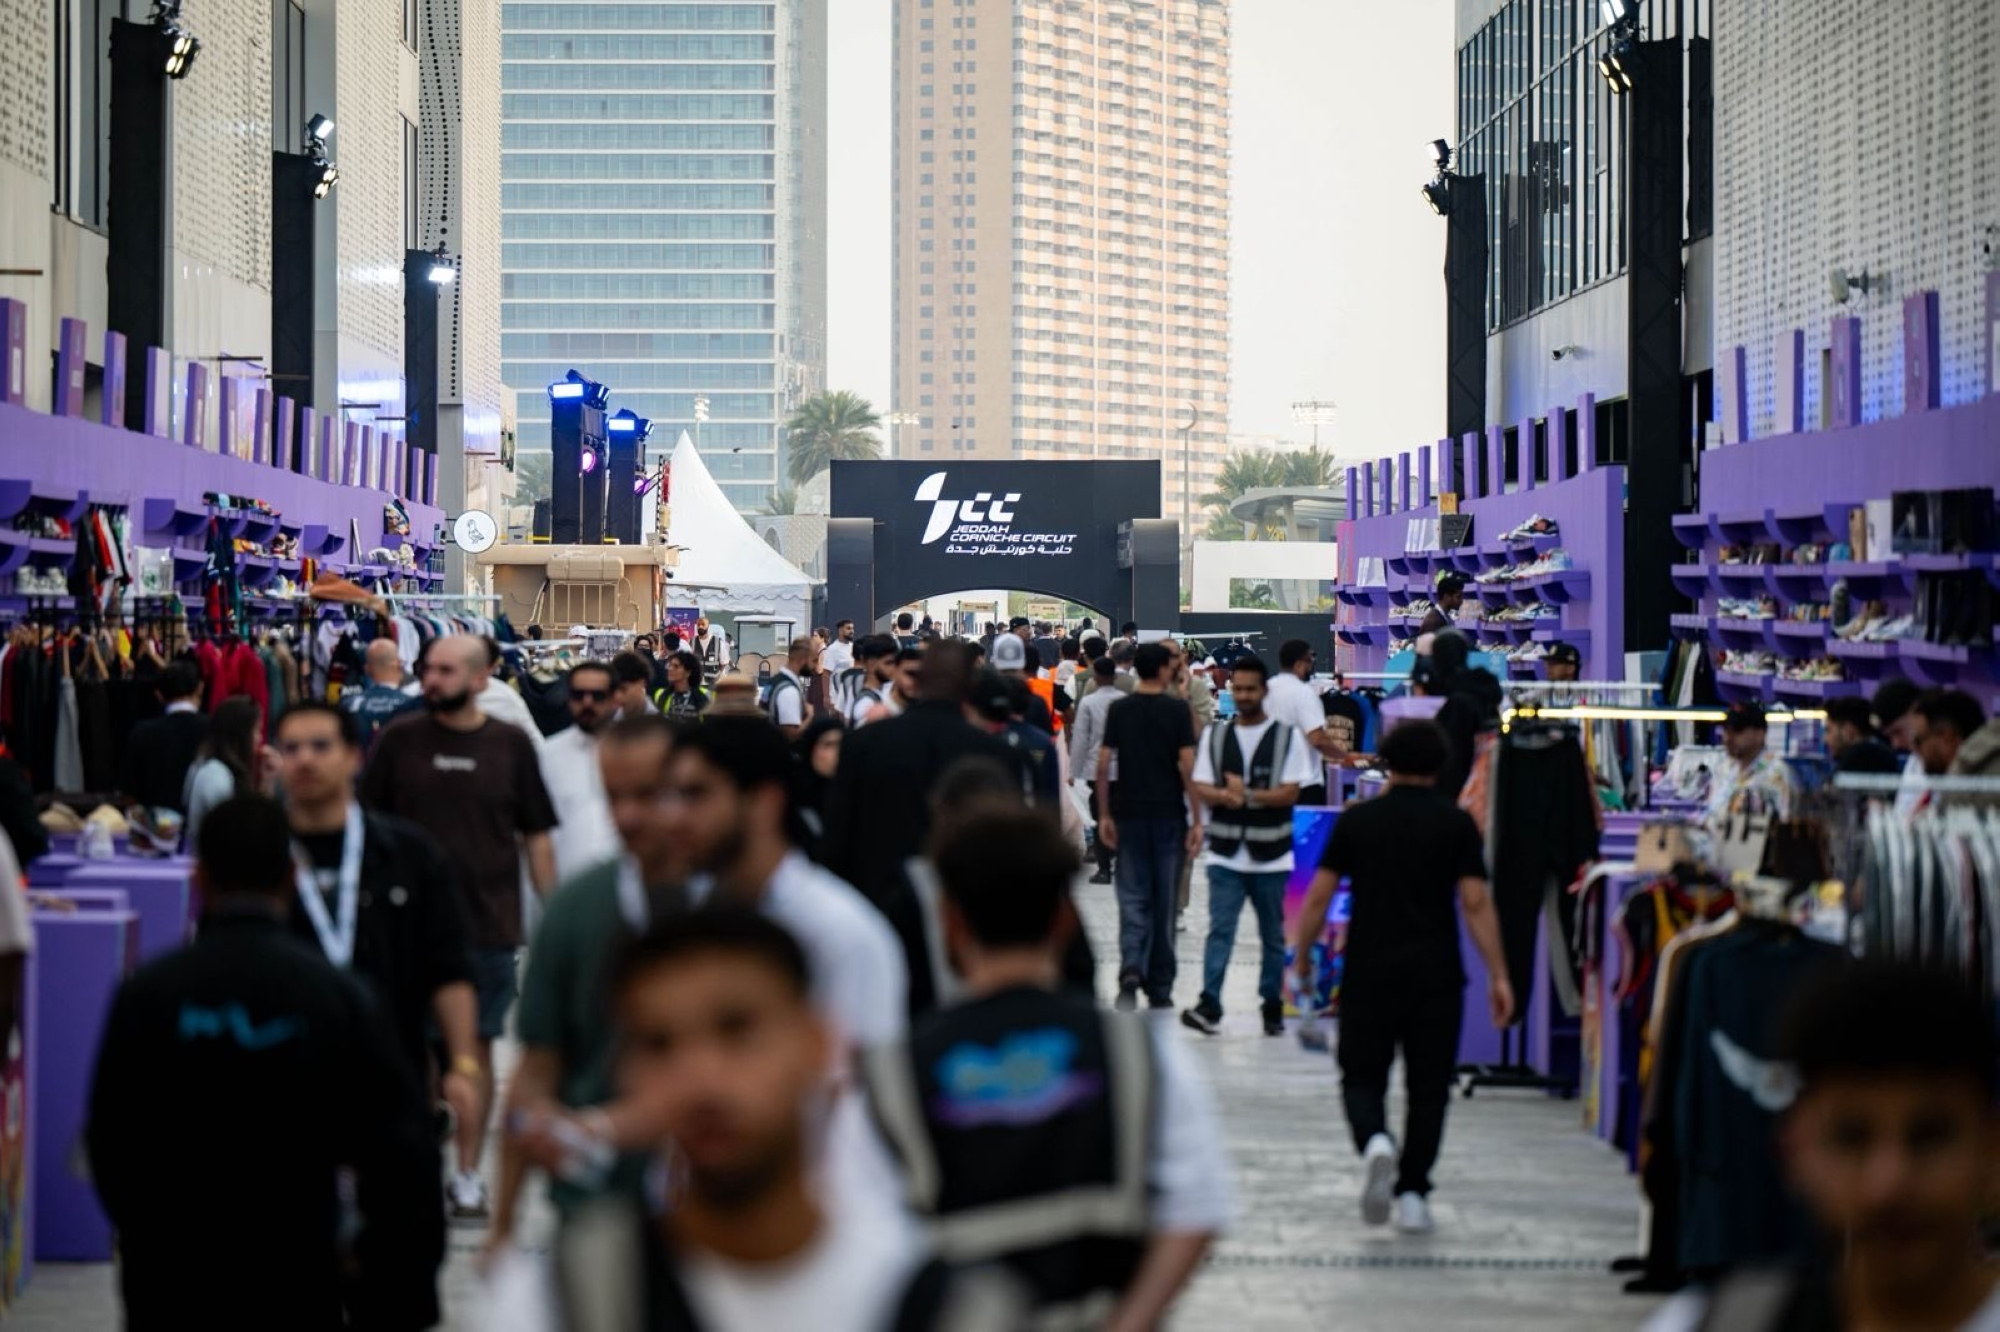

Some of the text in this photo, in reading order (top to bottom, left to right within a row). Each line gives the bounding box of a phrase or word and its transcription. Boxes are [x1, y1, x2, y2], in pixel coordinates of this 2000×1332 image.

[952, 524, 1010, 534] JEDDAH
[950, 533, 1077, 543] CORNICHE CIRCUIT
[945, 543, 1073, 557] حلبة كورنيش جدة
